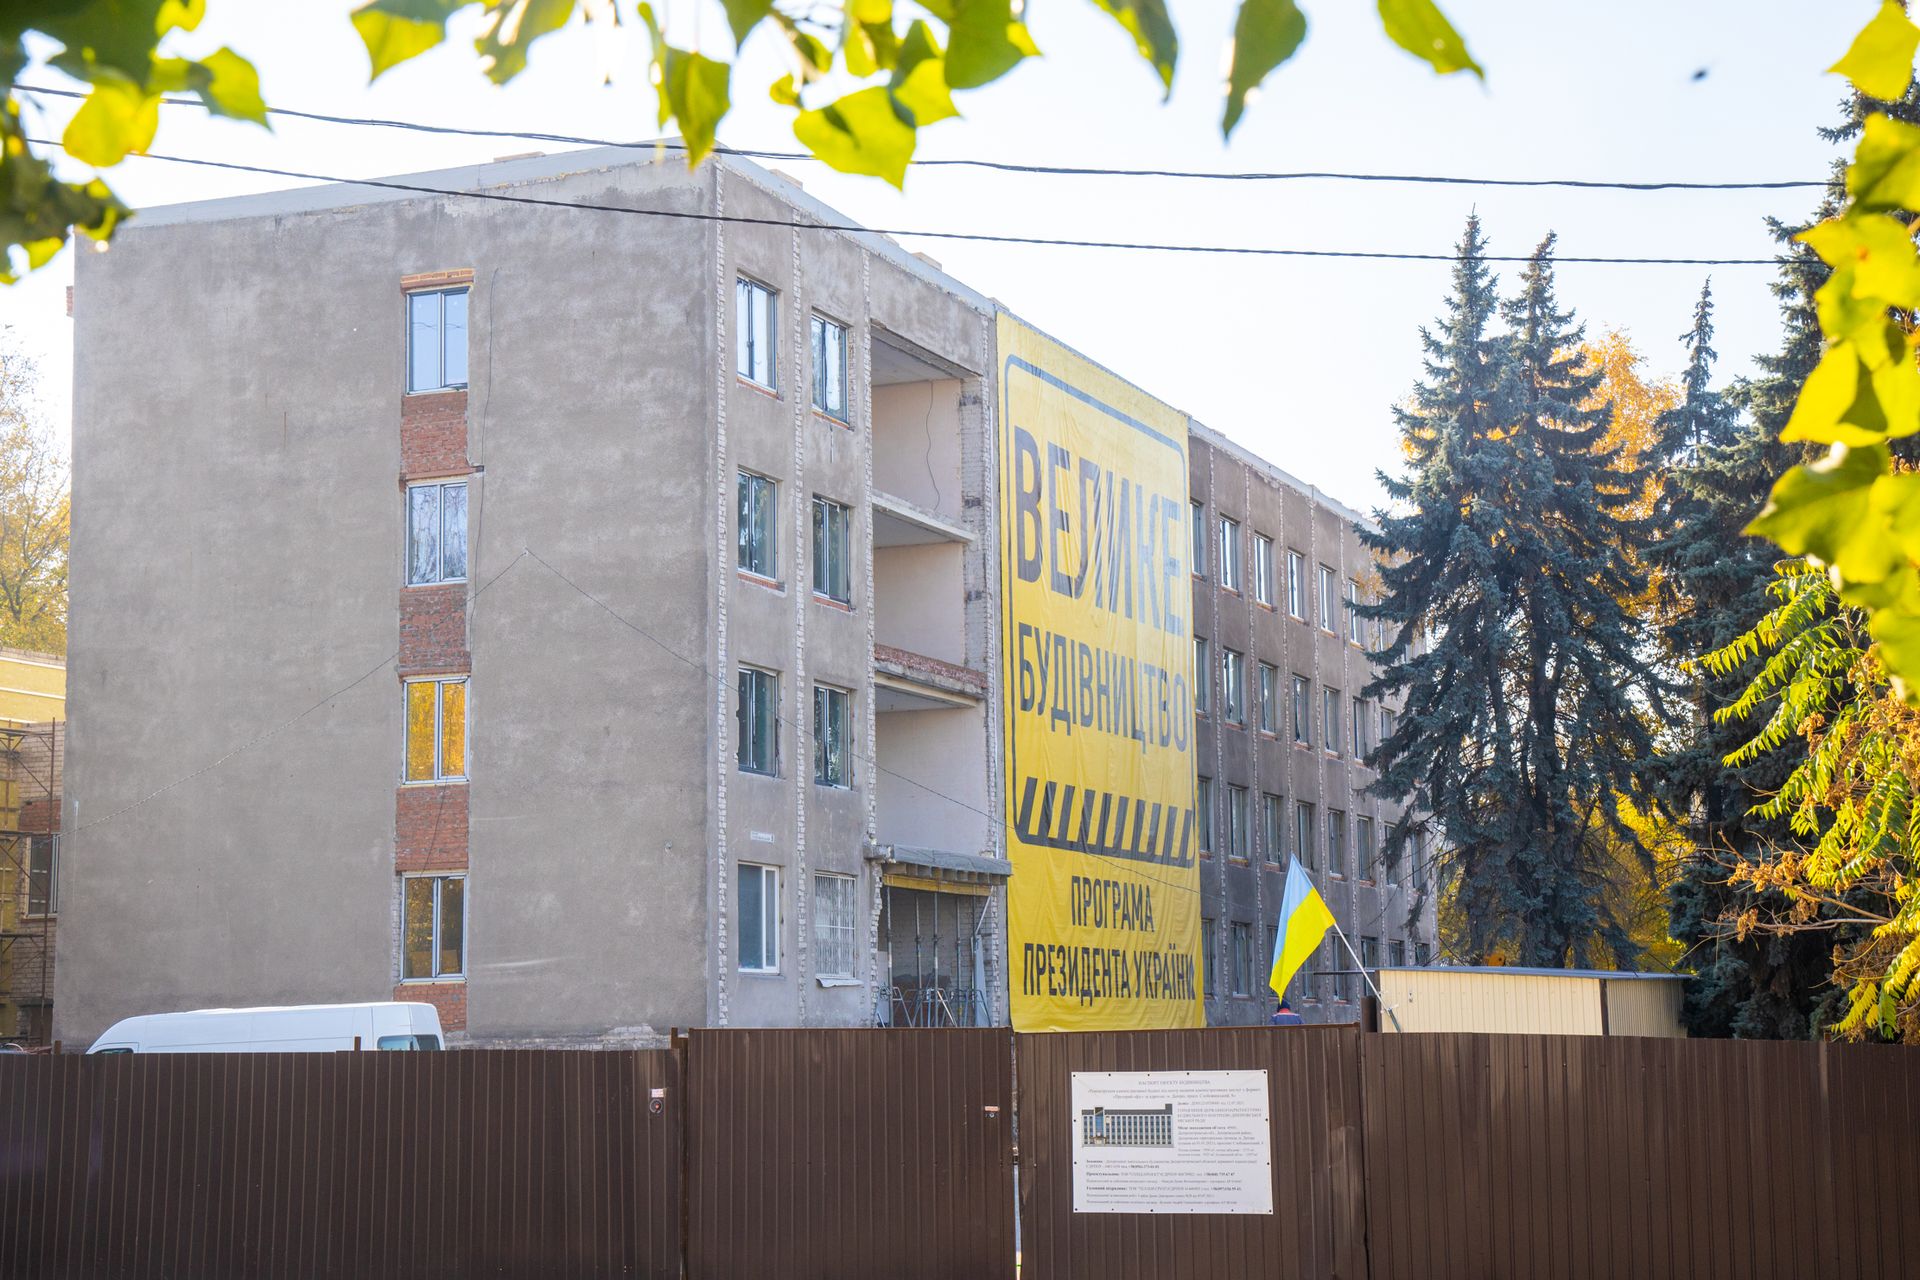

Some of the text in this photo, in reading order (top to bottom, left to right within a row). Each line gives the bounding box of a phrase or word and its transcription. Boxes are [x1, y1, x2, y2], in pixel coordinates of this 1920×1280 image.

[1014, 425, 1184, 637] ВЕЛИКЕ
[1018, 622, 1187, 753] БУДІВНИЦТВО
[1071, 876, 1154, 932] ПРОГРАМА
[1023, 943, 1195, 1006] ПРЕЗИДЕНТА УКРАЇНИ
